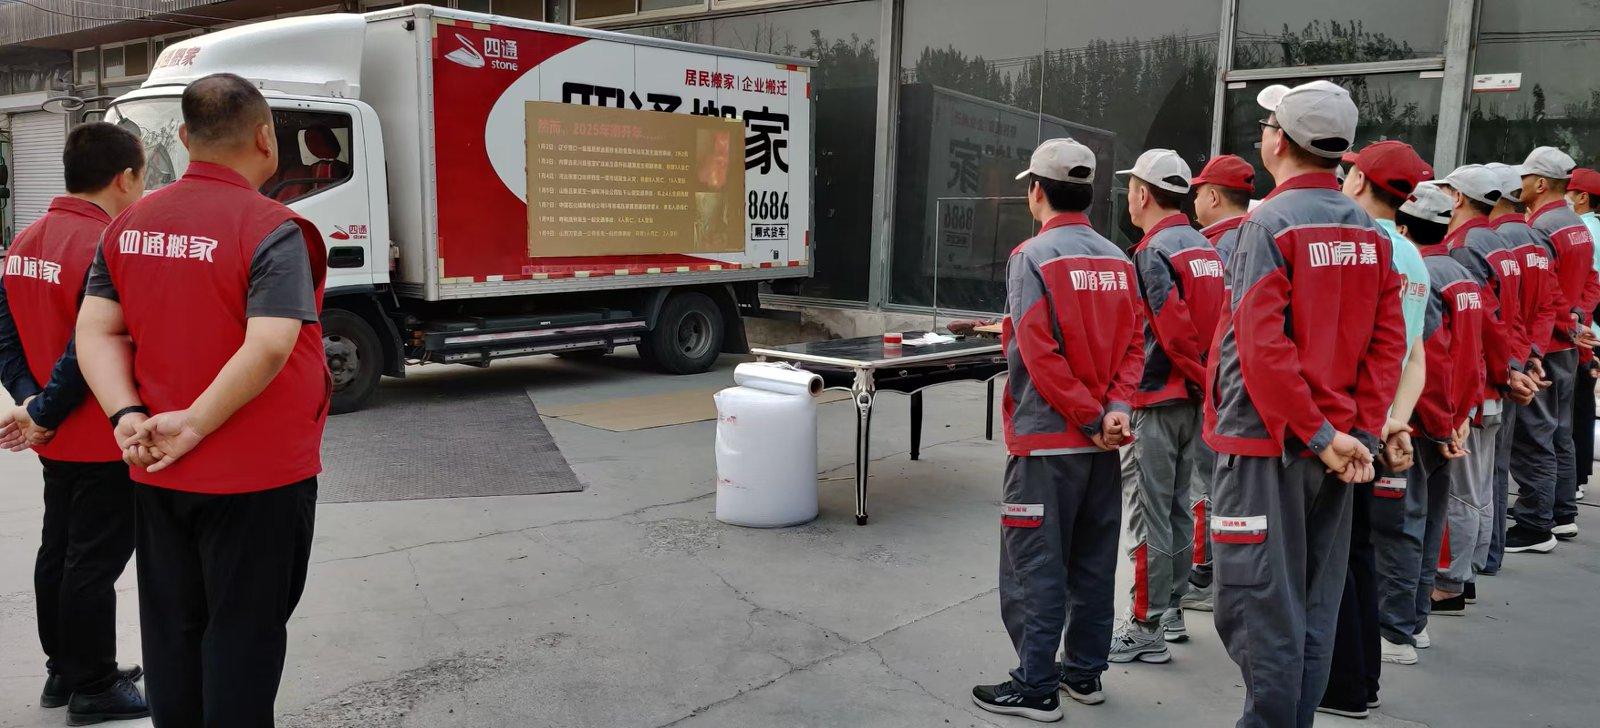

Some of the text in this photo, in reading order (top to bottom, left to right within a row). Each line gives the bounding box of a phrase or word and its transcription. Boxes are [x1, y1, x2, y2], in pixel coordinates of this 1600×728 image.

[484, 37, 518, 60] 四通
[491, 60, 518, 71] stone
[685, 69, 787, 96] 居民搬家 企业搬迁
[748, 190, 789, 220] 8686
[119, 229, 219, 263] 四通搬家
